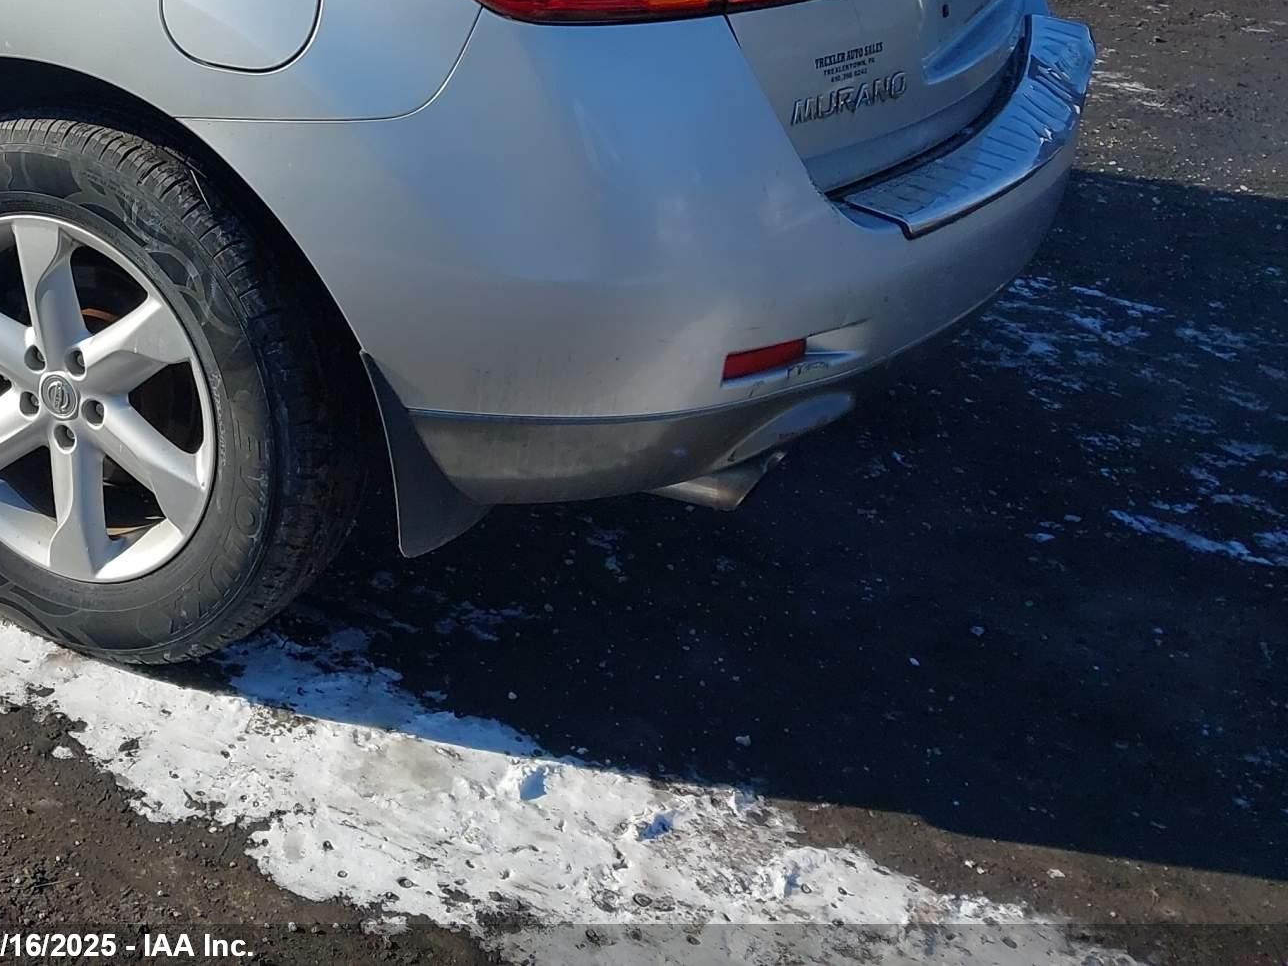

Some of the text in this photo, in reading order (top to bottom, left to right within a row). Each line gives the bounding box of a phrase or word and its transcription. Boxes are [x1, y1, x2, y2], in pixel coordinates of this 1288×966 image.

[846, 47, 864, 62] AUTO
[865, 42, 884, 57] SALES
[790, 70, 908, 126] MURANO
